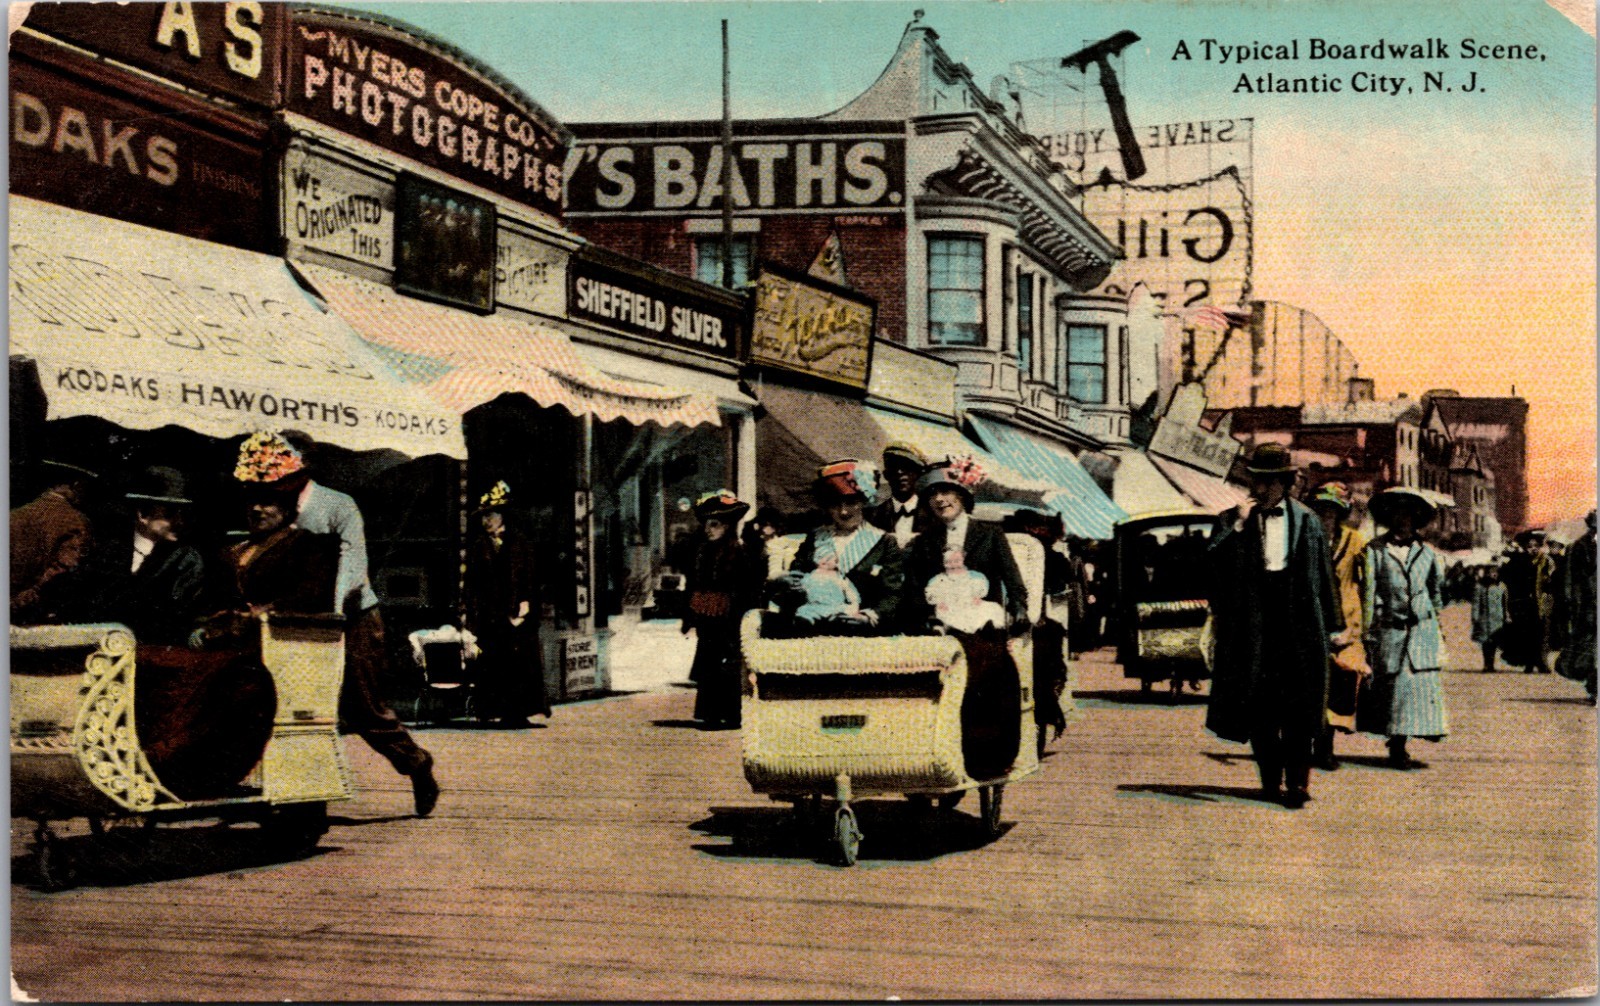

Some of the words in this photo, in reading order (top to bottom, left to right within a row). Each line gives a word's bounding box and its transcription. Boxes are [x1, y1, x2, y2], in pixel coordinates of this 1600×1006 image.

[328, 31, 426, 98] MYERS
[434, 80, 499, 133] COPE
[505, 113, 539, 150] CO.
[13, 92, 179, 186] DAKS
[304, 55, 562, 201] PHOTOGRAPHS
[292, 167, 321, 201] WE
[653, 141, 902, 208] BATHS.
[296, 194, 381, 238] ORIGINATED
[350, 227, 381, 258] THIS
[576, 276, 667, 333] SHEFFIELD
[57, 366, 160, 401] KODAKS
[181, 382, 360, 428] HAWORTH'S
[375, 409, 449, 436] KODAKS
